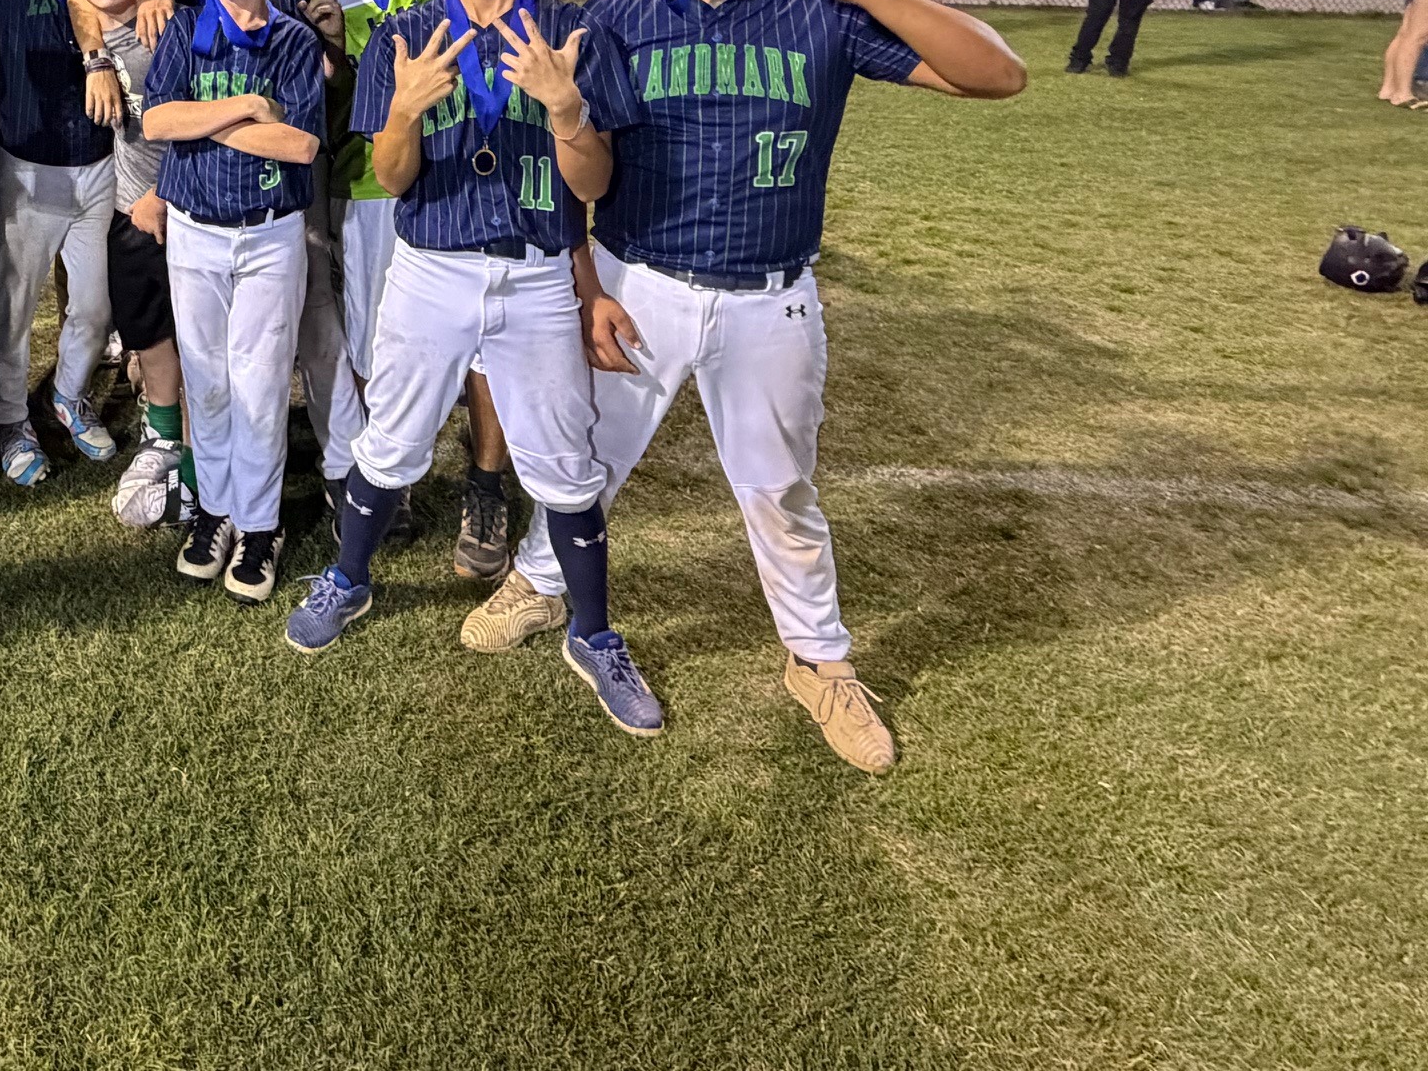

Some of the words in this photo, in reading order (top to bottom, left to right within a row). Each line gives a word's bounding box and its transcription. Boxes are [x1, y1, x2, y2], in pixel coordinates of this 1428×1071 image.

[753, 130, 808, 188] 17
[518, 155, 555, 211] 11
[152, 438, 175, 451] NIKE
[168, 468, 179, 492] NIKE
